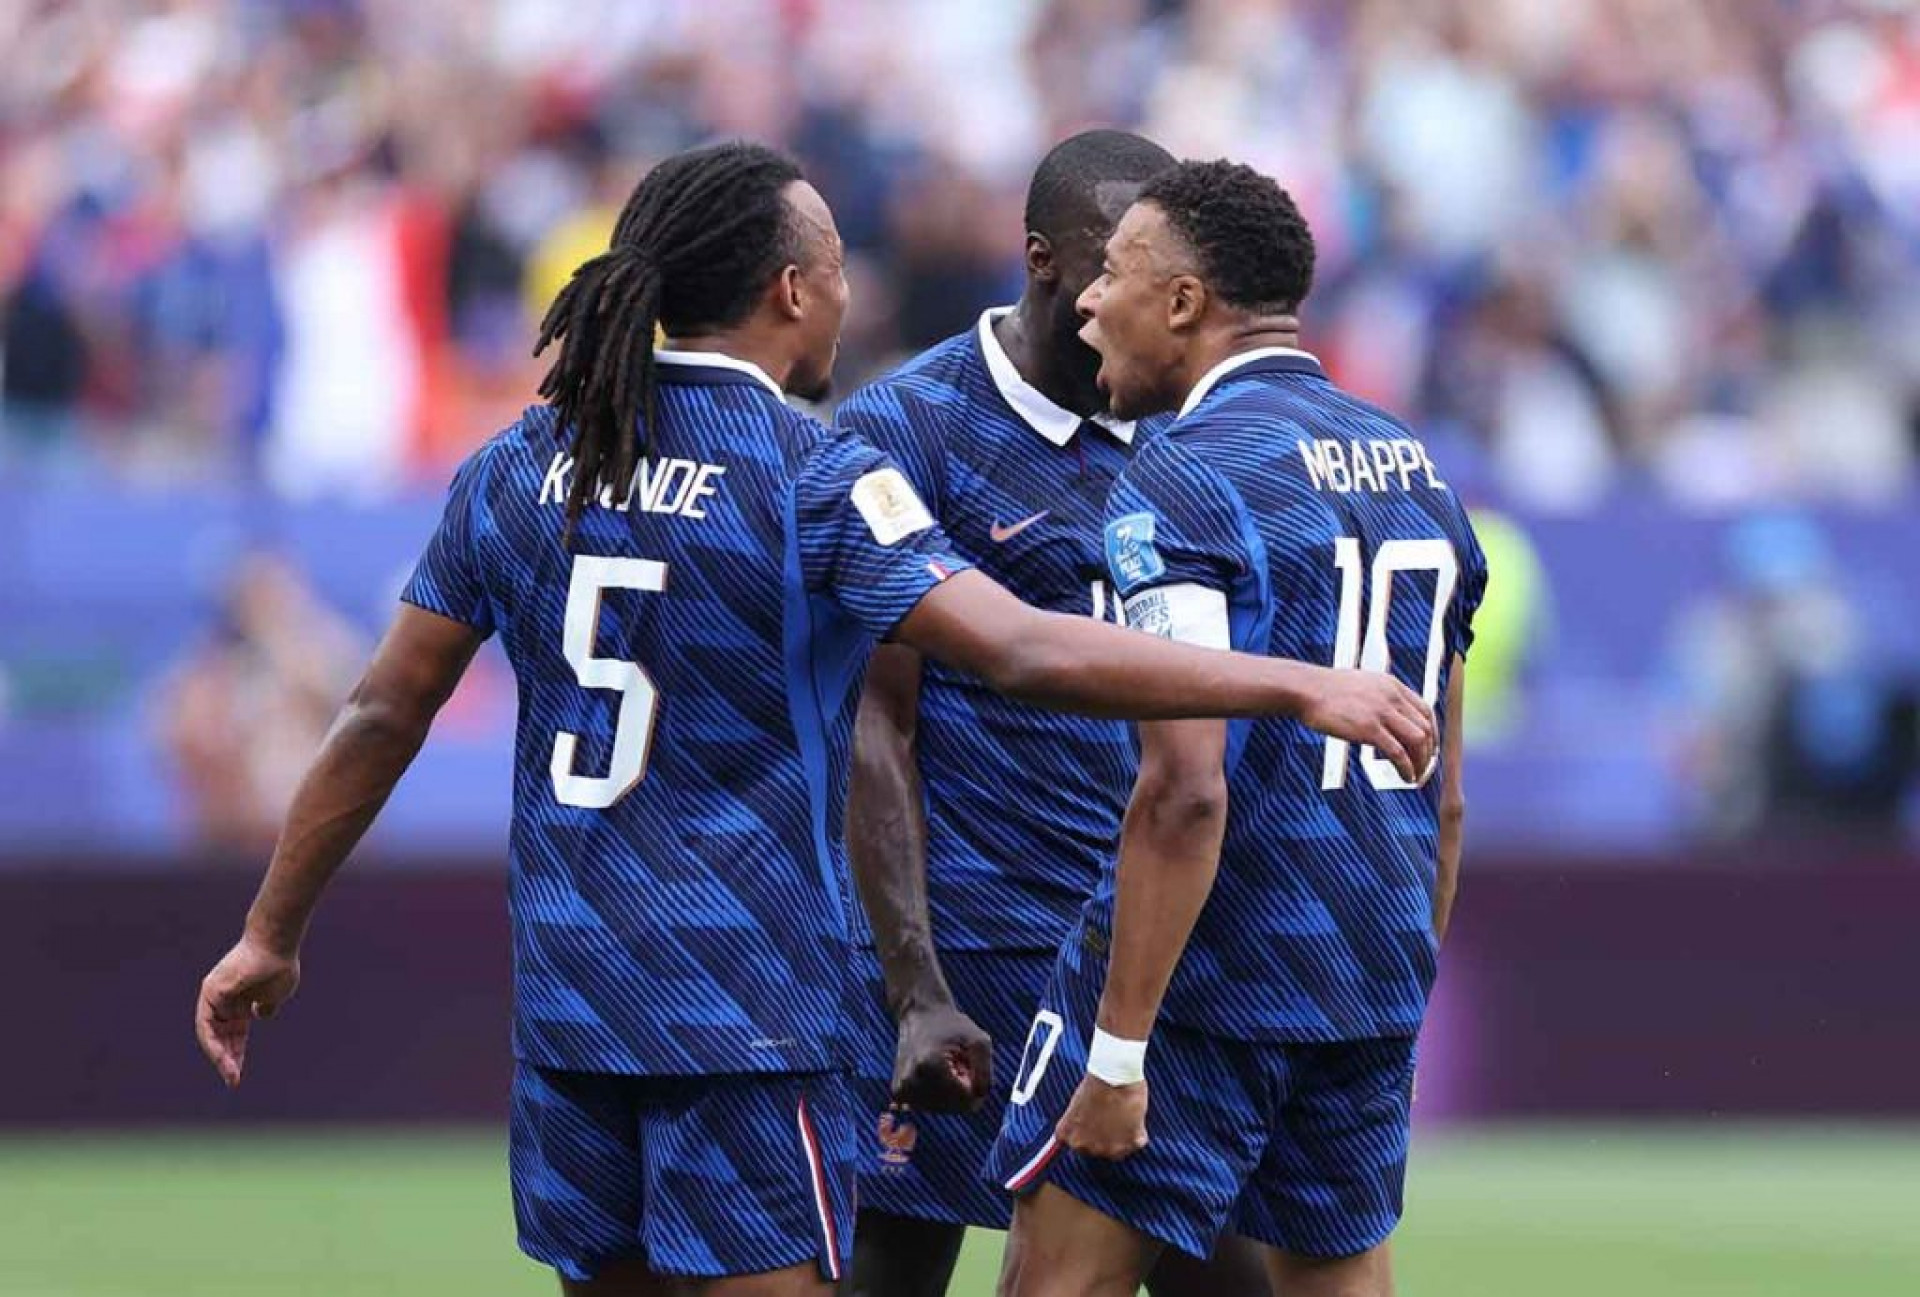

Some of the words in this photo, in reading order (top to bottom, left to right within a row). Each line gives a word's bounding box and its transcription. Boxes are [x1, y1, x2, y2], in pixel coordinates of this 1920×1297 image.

[539, 451, 727, 519] KNDE
[550, 554, 669, 809] 5
[1321, 537, 1458, 790] 10
[1010, 1009, 1064, 1105] 0
